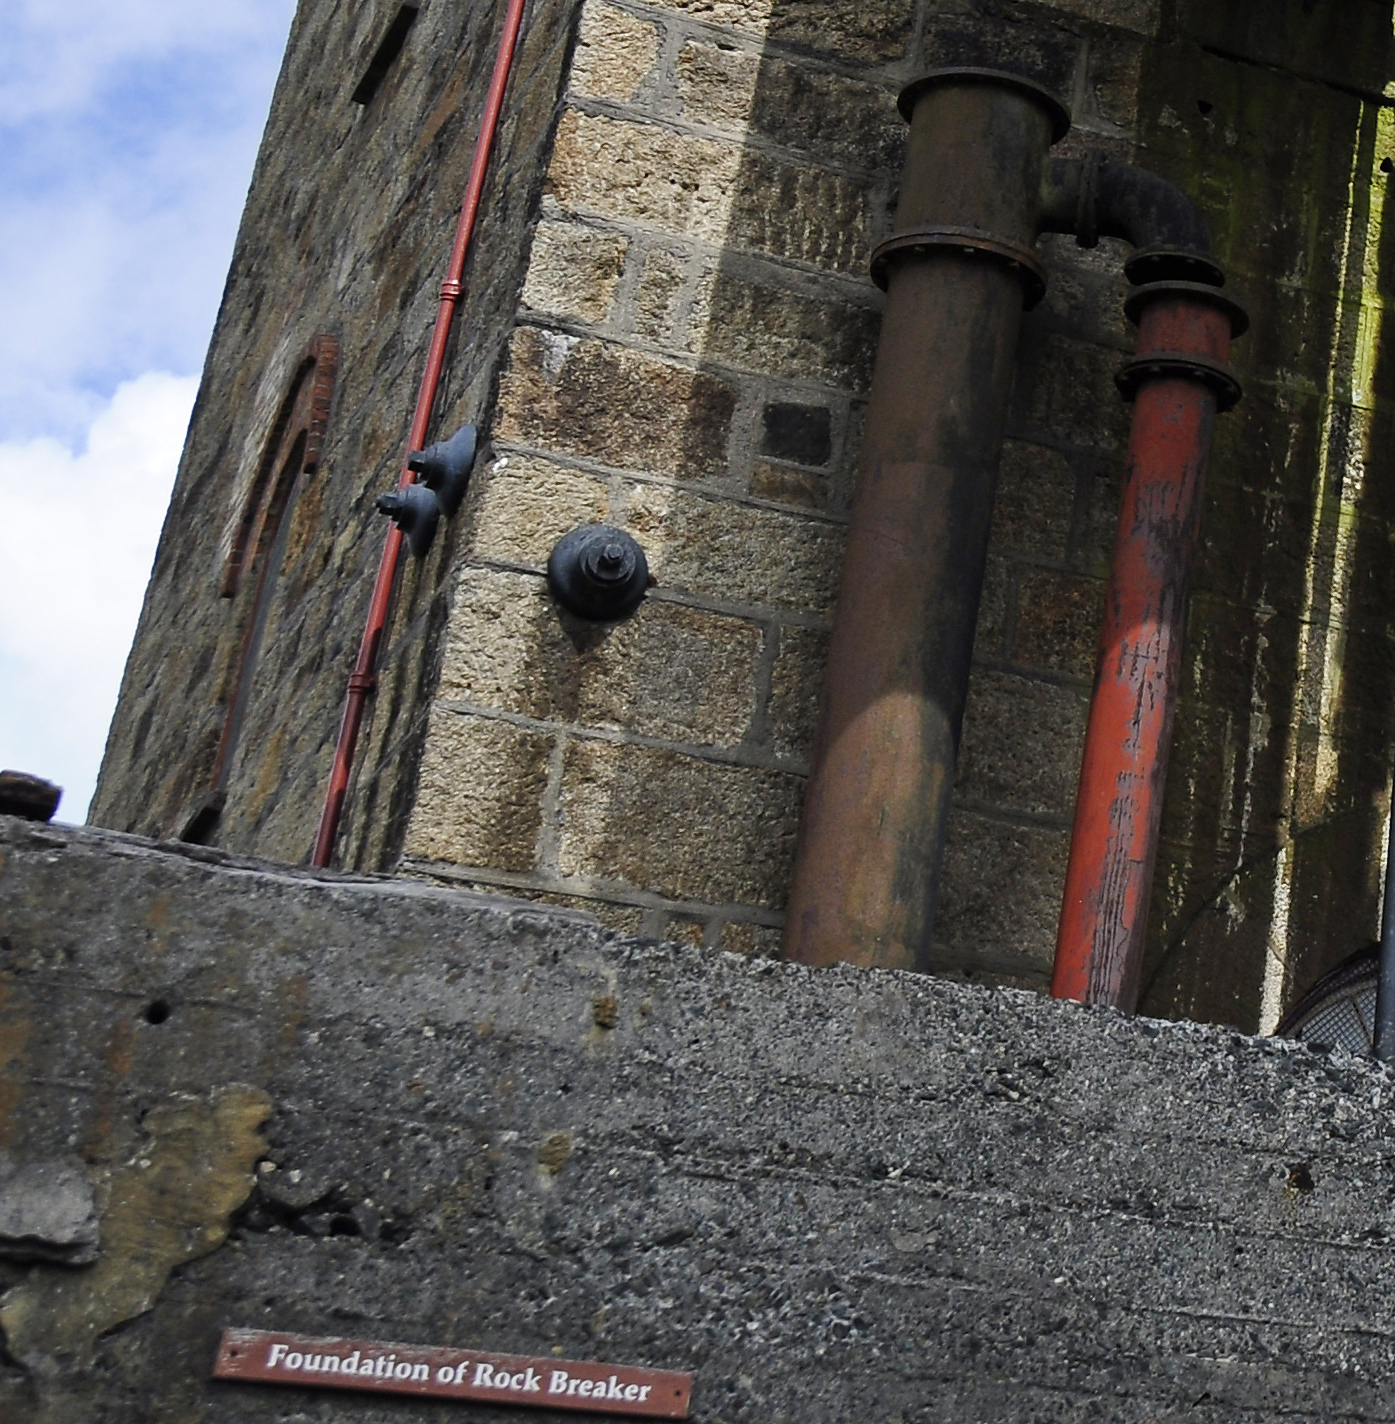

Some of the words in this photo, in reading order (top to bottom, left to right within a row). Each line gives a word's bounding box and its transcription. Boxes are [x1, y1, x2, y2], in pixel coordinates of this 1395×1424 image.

[266, 1343, 430, 1381] Foundation
[435, 1360, 470, 1385] of
[472, 1362, 542, 1393] Rock
[548, 1369, 652, 1403] Breaker
